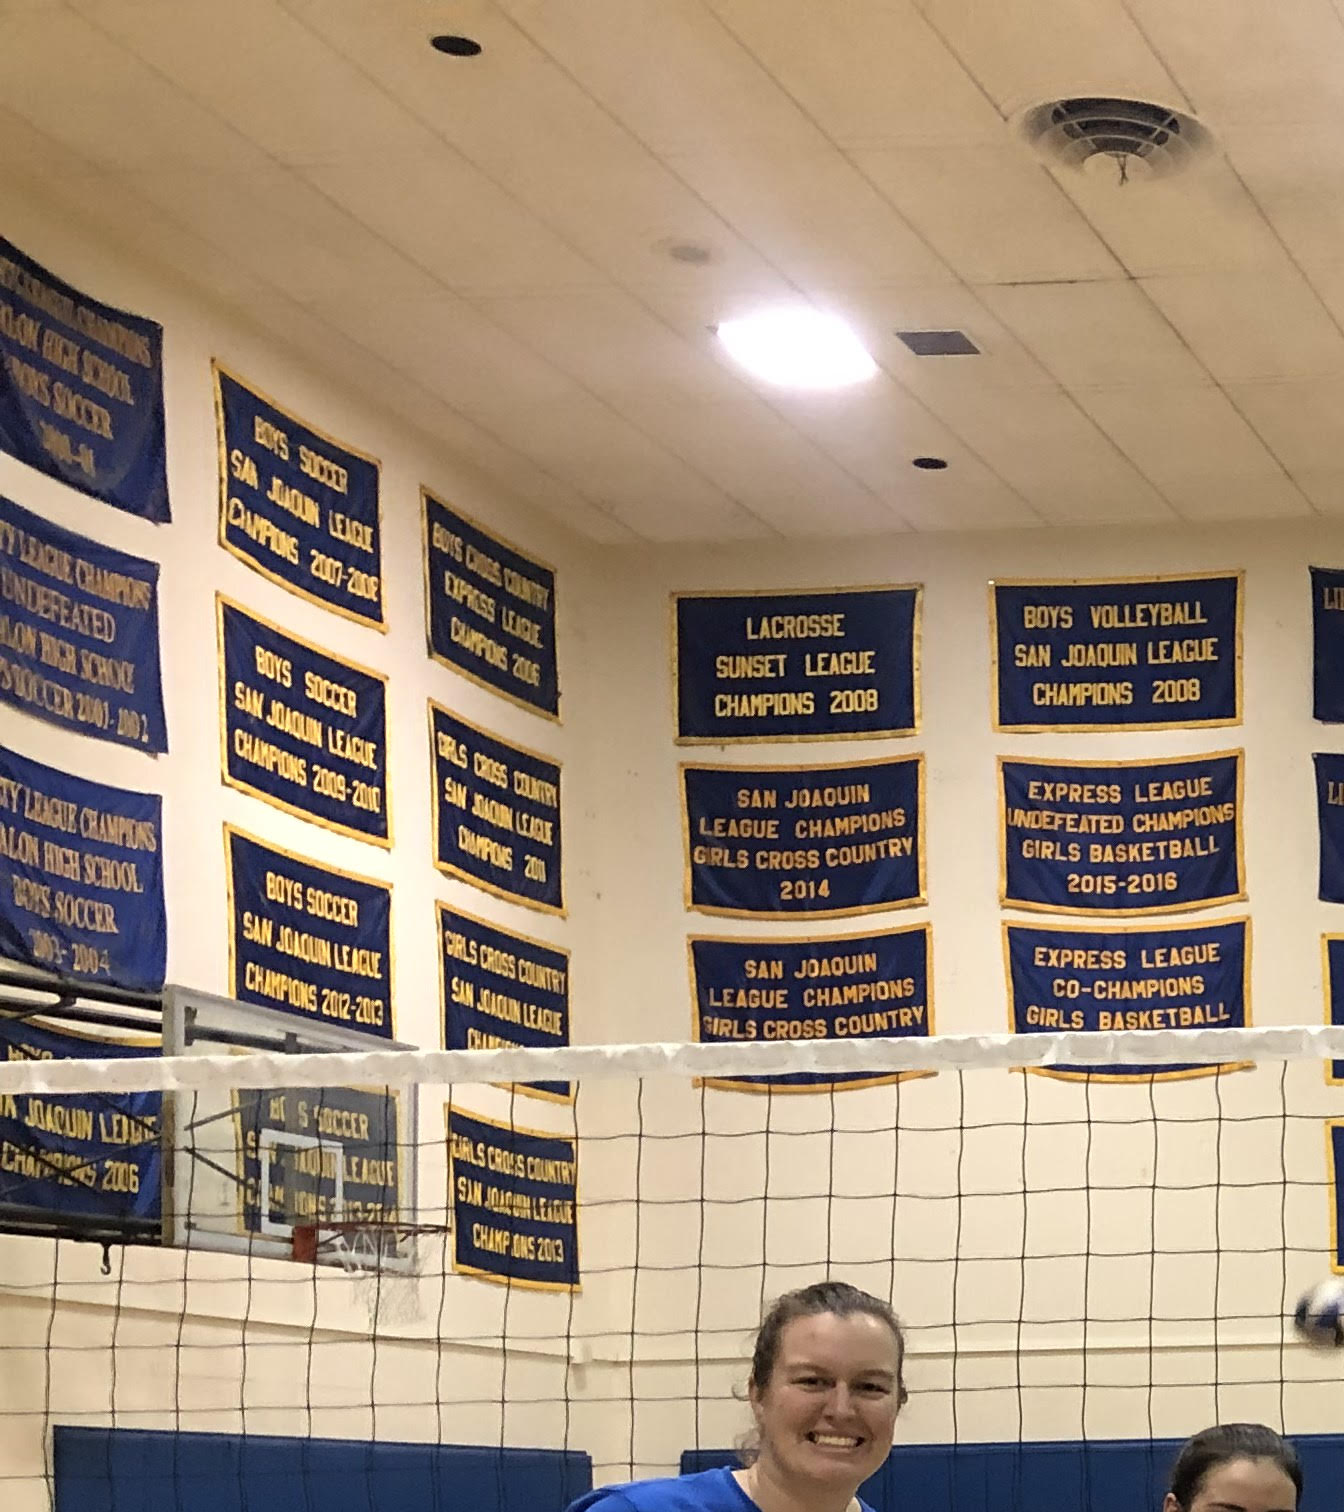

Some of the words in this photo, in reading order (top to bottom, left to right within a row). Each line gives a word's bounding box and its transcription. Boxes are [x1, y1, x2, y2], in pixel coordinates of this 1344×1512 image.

[747, 614, 845, 640] LACROSSE
[1024, 605, 1072, 629] BOYS
[1090, 601, 1208, 629] VOLLEYBALL
[716, 655, 787, 678] SUNSET
[805, 651, 876, 676] LEAGUE
[1015, 644, 1050, 667] SAN
[1061, 643, 1137, 667] JOAQUIN
[1147, 637, 1218, 664] LEAGUE
[715, 692, 814, 717] CHAMPIONS
[830, 689, 879, 713] 2008
[1033, 682, 1133, 706] CHAMPIONS
[1152, 678, 1200, 703] 2008
[737, 789, 776, 809] SAN
[785, 784, 870, 808] JOAQUIN
[1028, 780, 1121, 803] EXPRESS
[1135, 777, 1213, 802] LEAGUE
[25, 788, 77, 834] LEAGUE
[80, 807, 156, 852] CHAMPIONS
[700, 817, 779, 839] LEAGUE
[795, 808, 905, 839] CHAMPIONS
[1008, 807, 1124, 834] UNDEFEATED
[1133, 803, 1234, 833] CHAMPIONS
[694, 846, 748, 868] GIRLS
[756, 849, 820, 869] CROSS
[826, 837, 913, 867] COUNTRY
[1022, 839, 1080, 862] GIRLS
[1090, 836, 1220, 863] BASKETBALL
[44, 842, 80, 881] HIGH
[84, 854, 143, 893] SCHOOL
[780, 879, 830, 900] 2014
[1067, 872, 1177, 894] 2015-2016
[55, 891, 119, 933] SOCCER
[266, 871, 303, 910] BOYS
[307, 888, 358, 927] SOCCER
[243, 912, 272, 947] SAN
[276, 925, 330, 967] JOAQUIN
[334, 943, 382, 979] LEAGUE
[246, 963, 317, 1012] CHAMPIONS
[322, 988, 383, 1026] 2012-2013
[488, 1147, 524, 1178] CROSS
[528, 1157, 575, 1184] COUNTRY
[473, 1223, 535, 1260] CHAMPIONS
[538, 1238, 564, 1262] 2013
